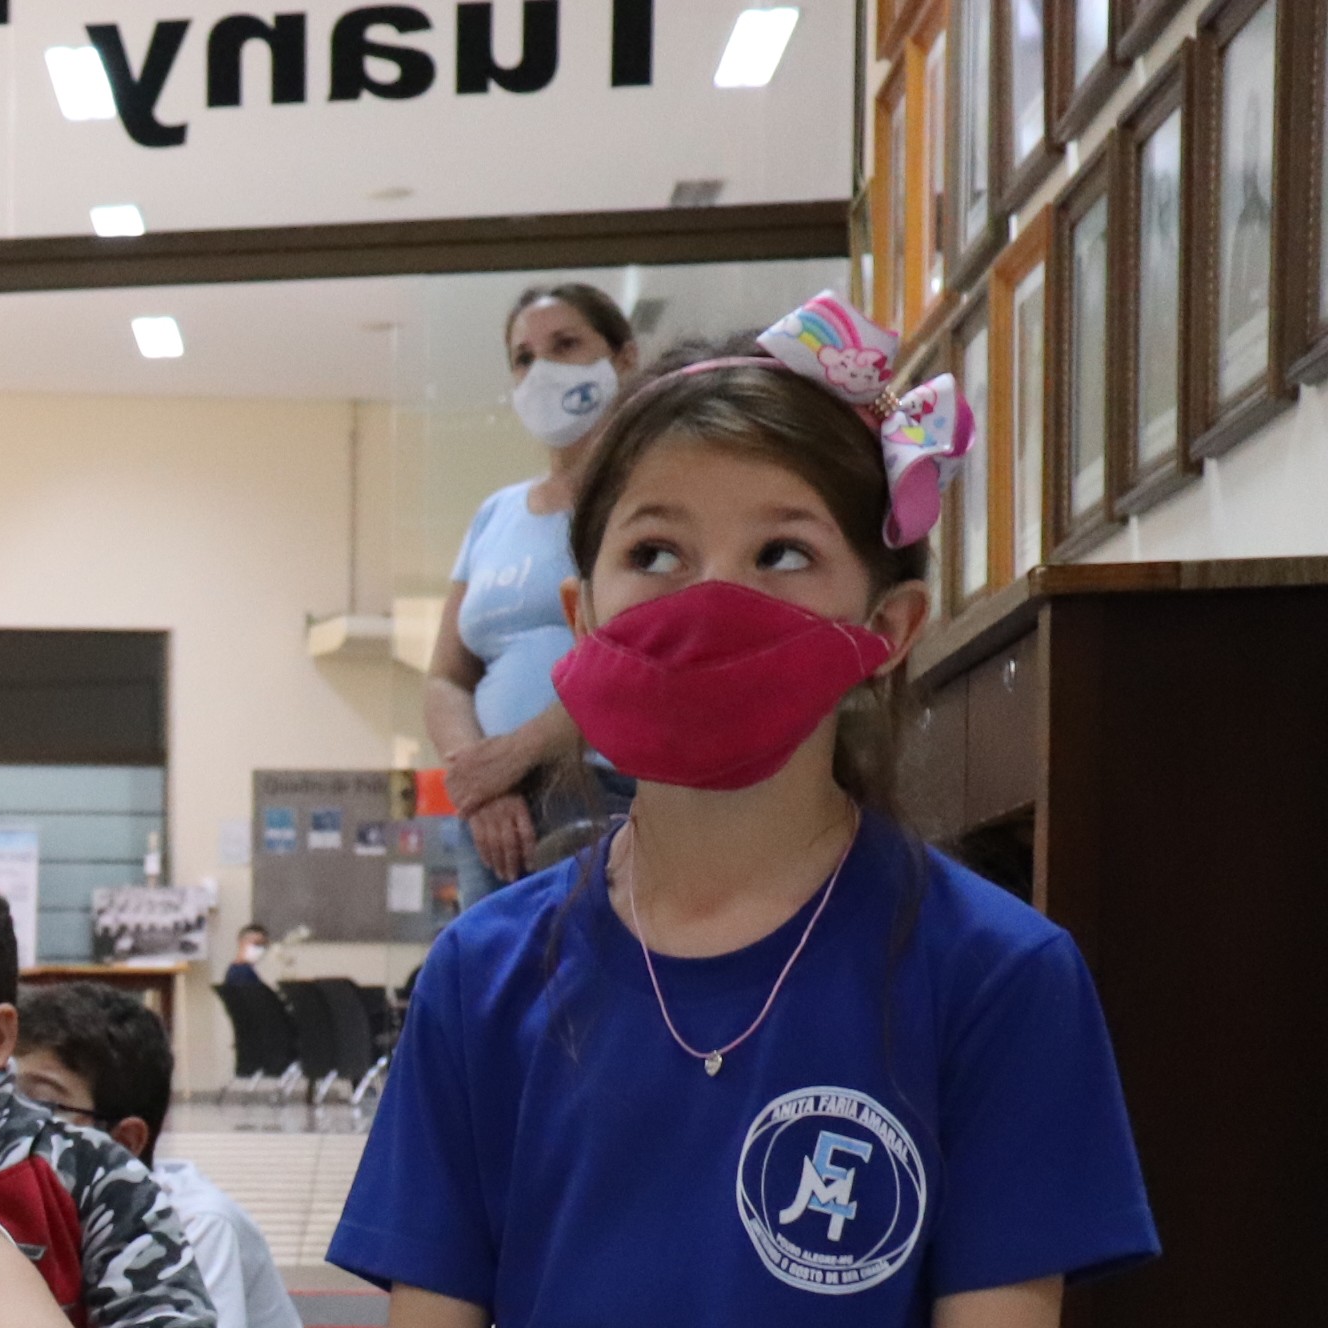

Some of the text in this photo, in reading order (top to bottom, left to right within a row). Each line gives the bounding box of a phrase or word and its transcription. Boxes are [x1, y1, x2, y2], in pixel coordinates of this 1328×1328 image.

[771, 1095, 911, 1164] ANITA FARIA AMARAL
